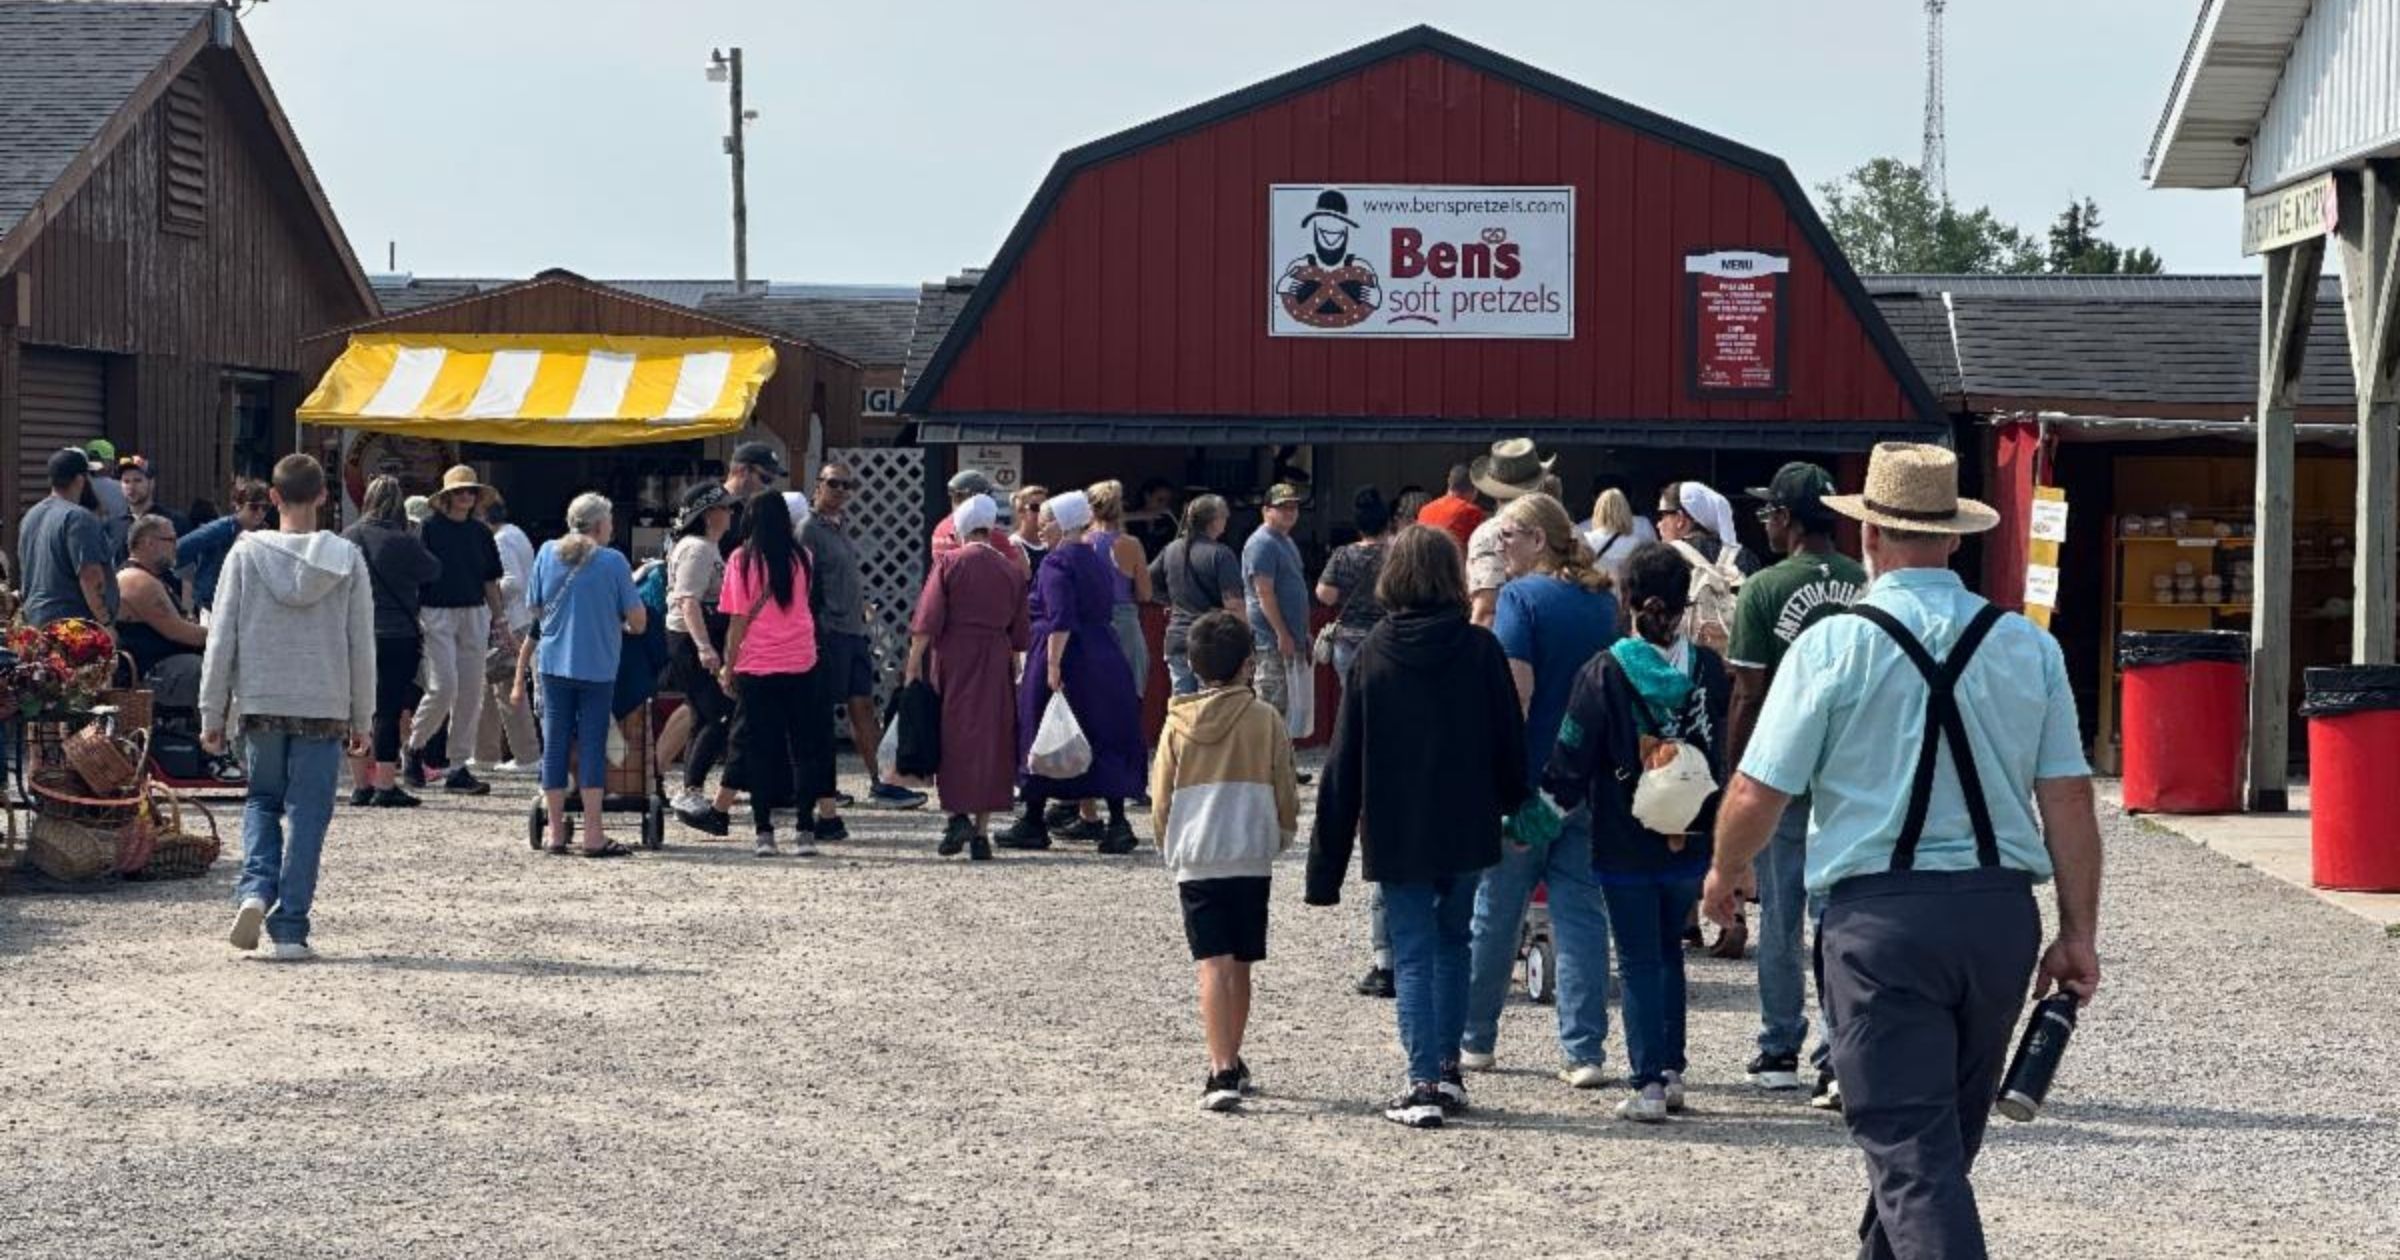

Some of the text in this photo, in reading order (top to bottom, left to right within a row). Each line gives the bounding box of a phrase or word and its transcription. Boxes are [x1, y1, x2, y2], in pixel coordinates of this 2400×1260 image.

[1363, 195, 1566, 217] www.benspretzels.com
[1721, 259, 1753, 271] MENU
[1389, 281, 1561, 321] soft pretzels
